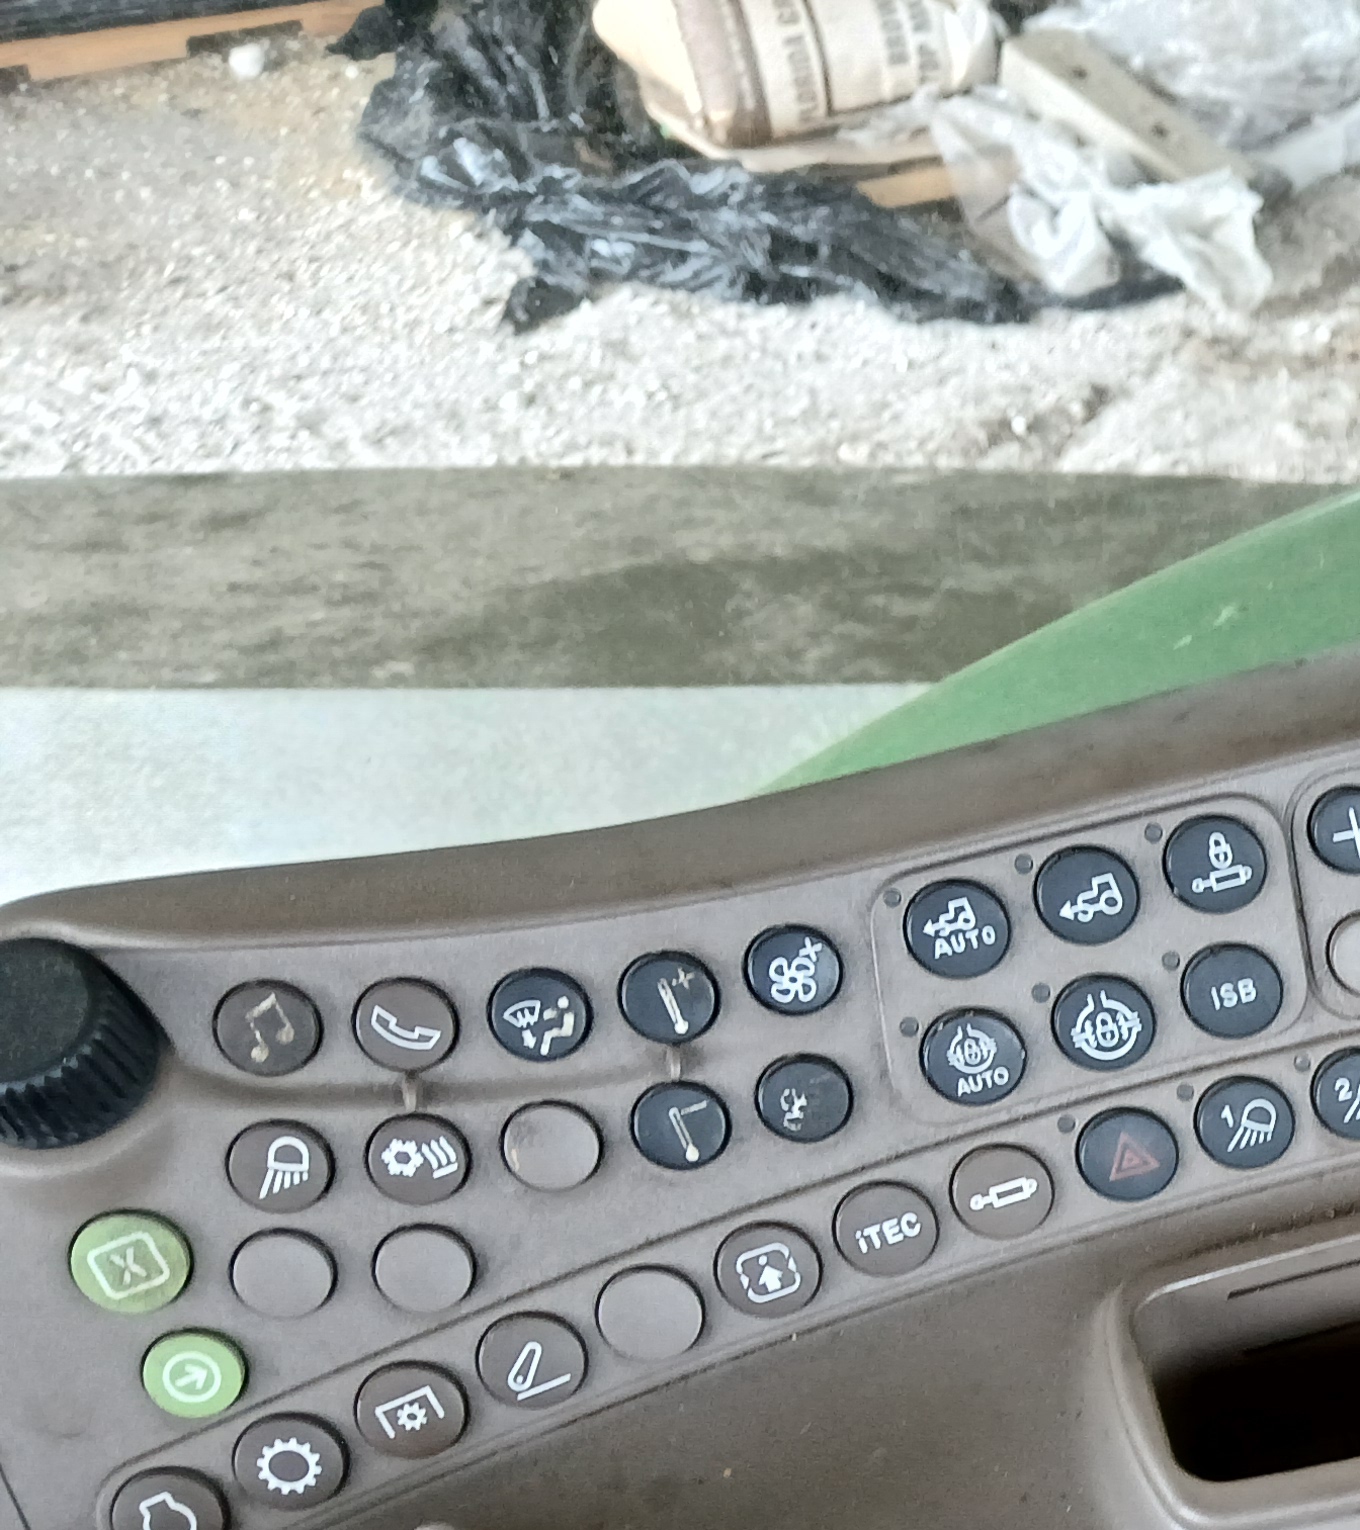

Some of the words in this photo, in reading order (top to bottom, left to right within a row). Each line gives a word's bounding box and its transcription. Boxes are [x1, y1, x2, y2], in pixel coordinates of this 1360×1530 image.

[934, 925, 996, 960] AUTO
[1210, 977, 1257, 1011] ISB
[956, 1066, 1010, 1097] AUTO
[1334, 1077, 1353, 1102] 2
[1220, 1104, 1235, 1129] 1
[854, 1211, 922, 1254] iTEC
